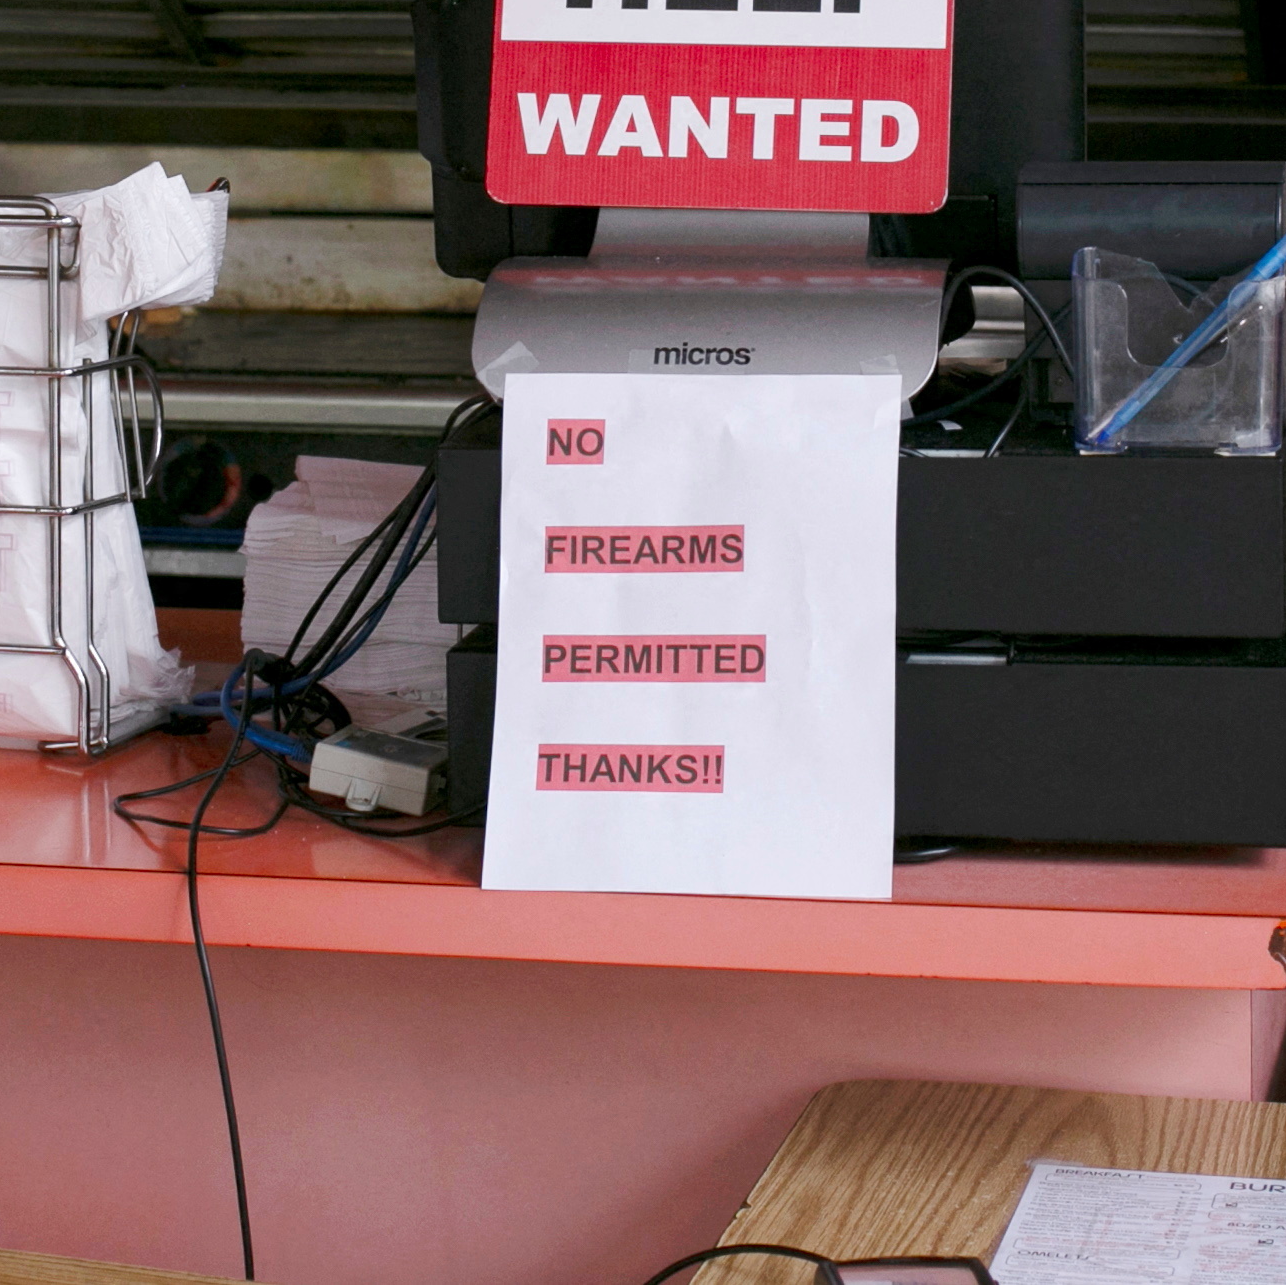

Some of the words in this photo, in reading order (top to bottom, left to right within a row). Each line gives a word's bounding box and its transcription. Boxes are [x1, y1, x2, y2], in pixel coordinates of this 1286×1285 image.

[517, 92, 920, 163] WANTED
[653, 342, 751, 366] micros
[548, 428, 604, 456] NO
[546, 534, 743, 565] FIREARMS
[543, 644, 764, 674] PERMITTED
[539, 753, 723, 785] THANKS!!
[1055, 1168, 1146, 1180] BREAKFAST
